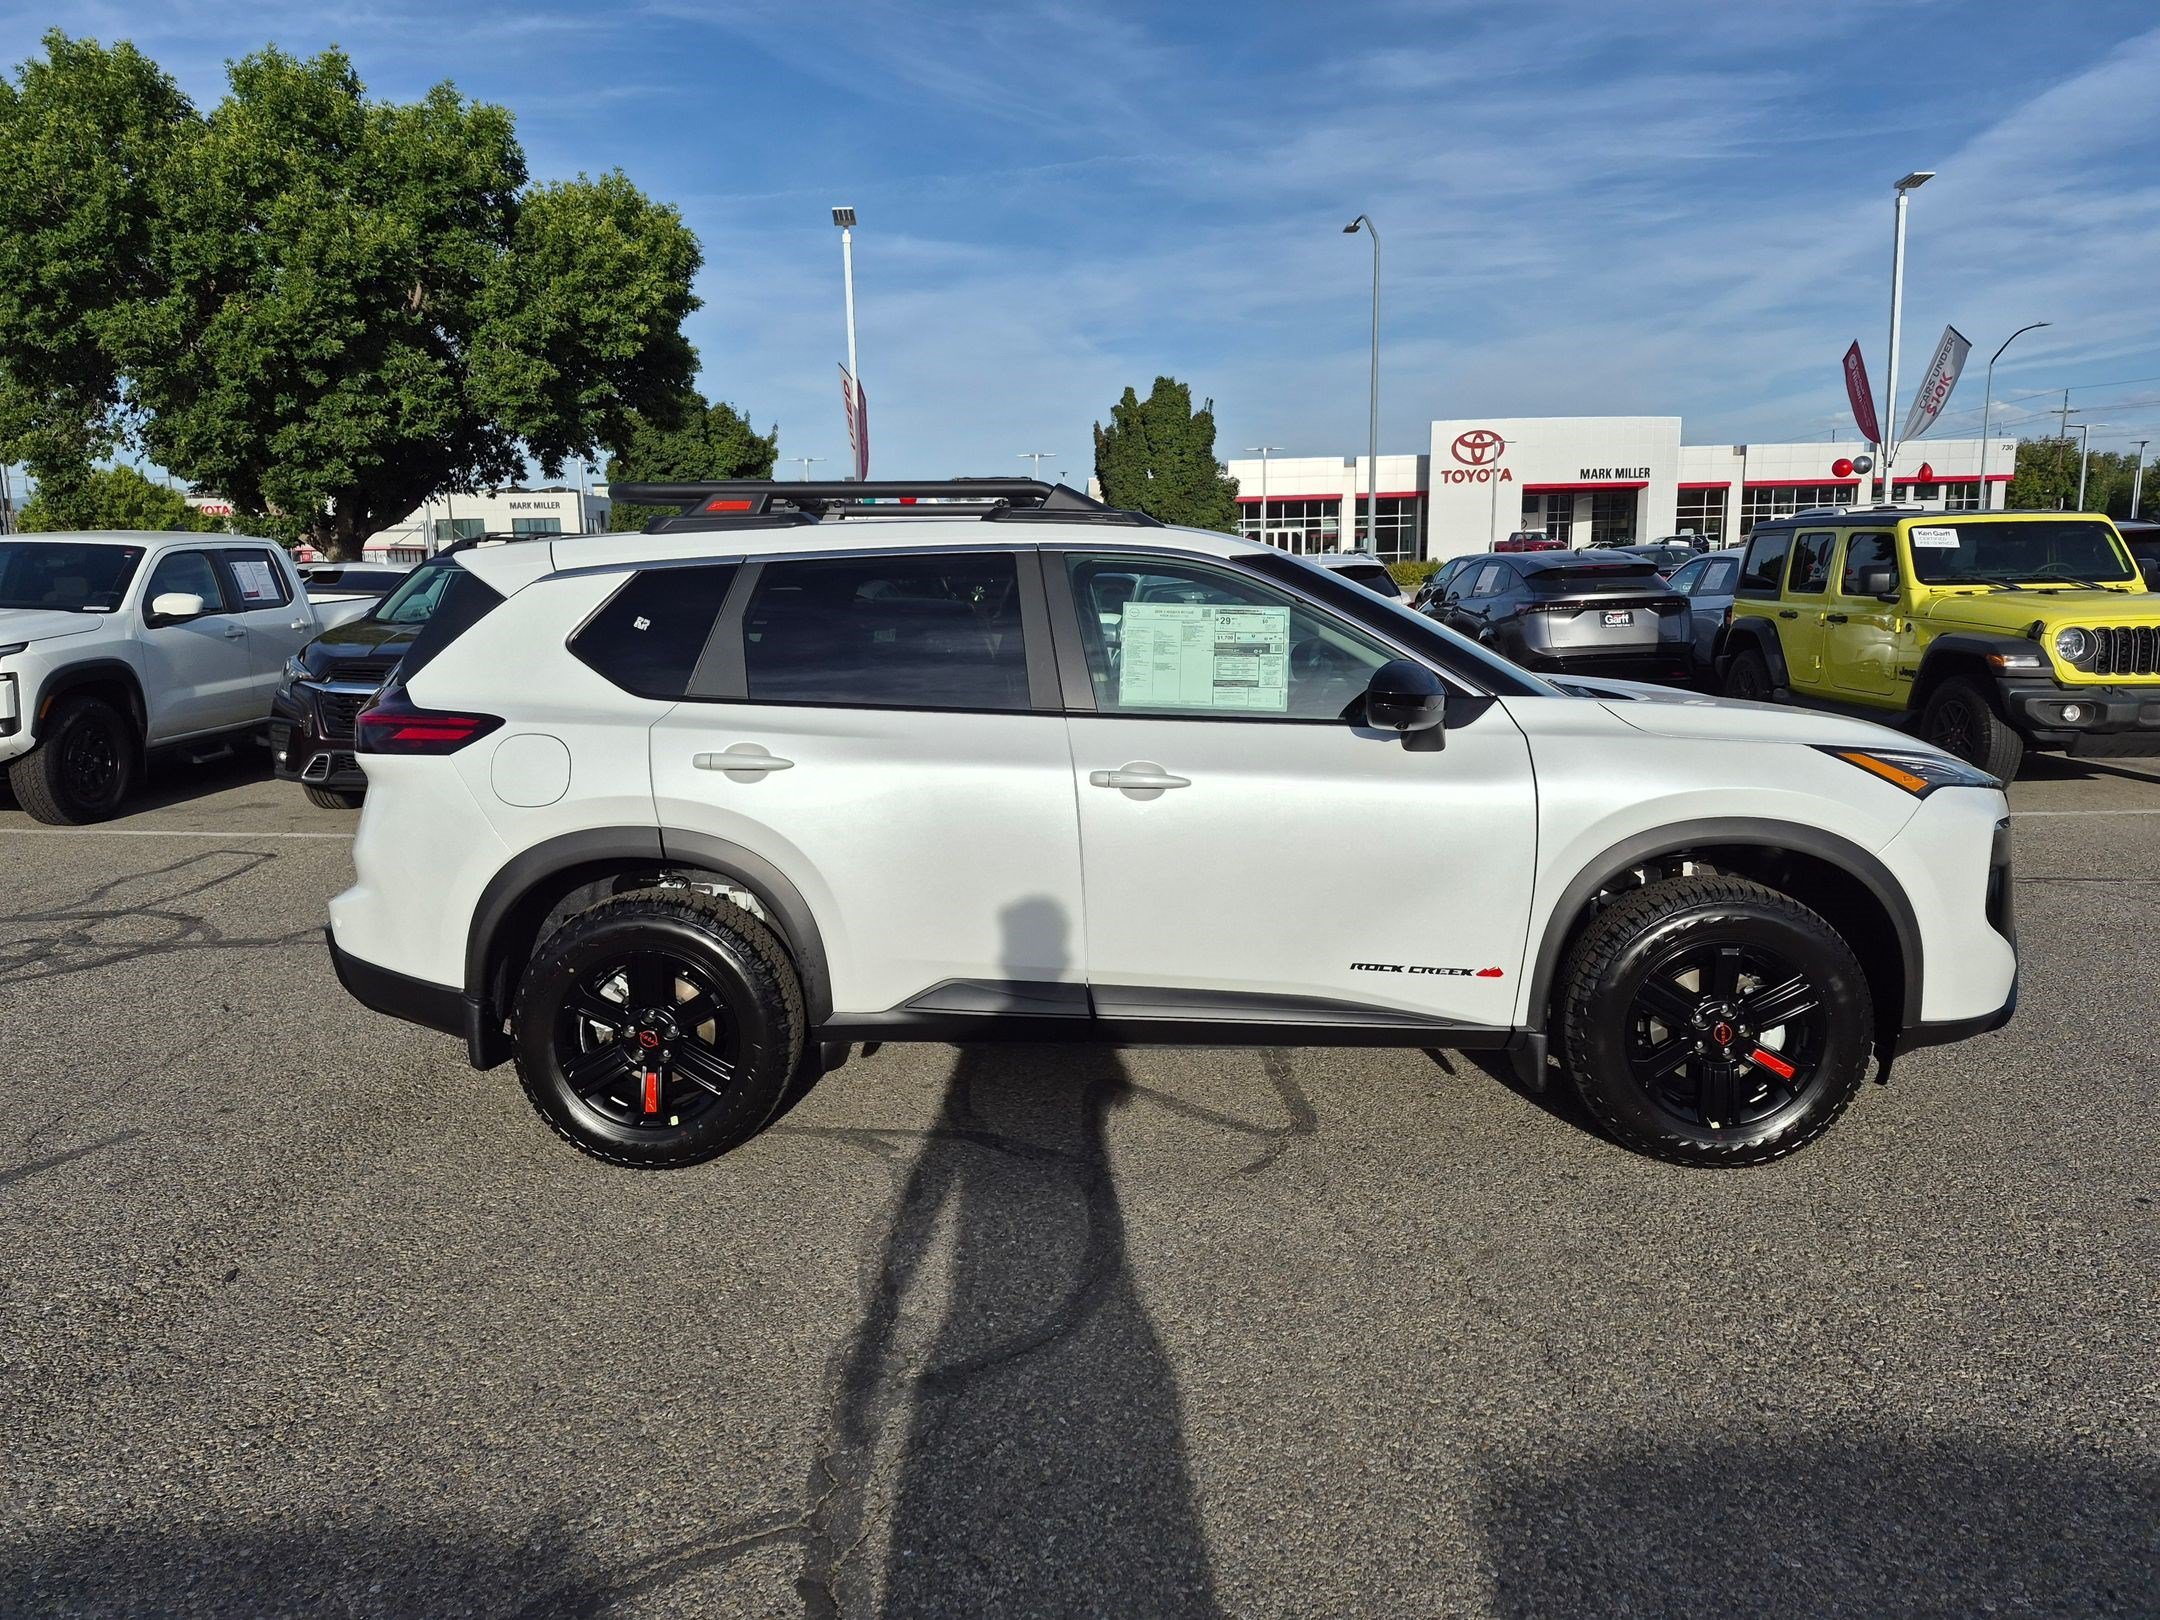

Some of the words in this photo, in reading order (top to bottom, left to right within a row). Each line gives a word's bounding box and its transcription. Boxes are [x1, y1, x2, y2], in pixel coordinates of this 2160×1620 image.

[1919, 378, 1936, 410] CARS
[1934, 336, 1955, 378] UNDER
[1580, 467, 1613, 480] MARK
[1614, 467, 1651, 480] MILLER
[509, 502, 532, 510] MARK
[533, 501, 561, 510] MILLER
[1220, 617, 1231, 625] 29
[1605, 614, 1629, 623] Garff
[1350, 962, 1405, 973] ROCK
[1408, 966, 1475, 977] CREEK
